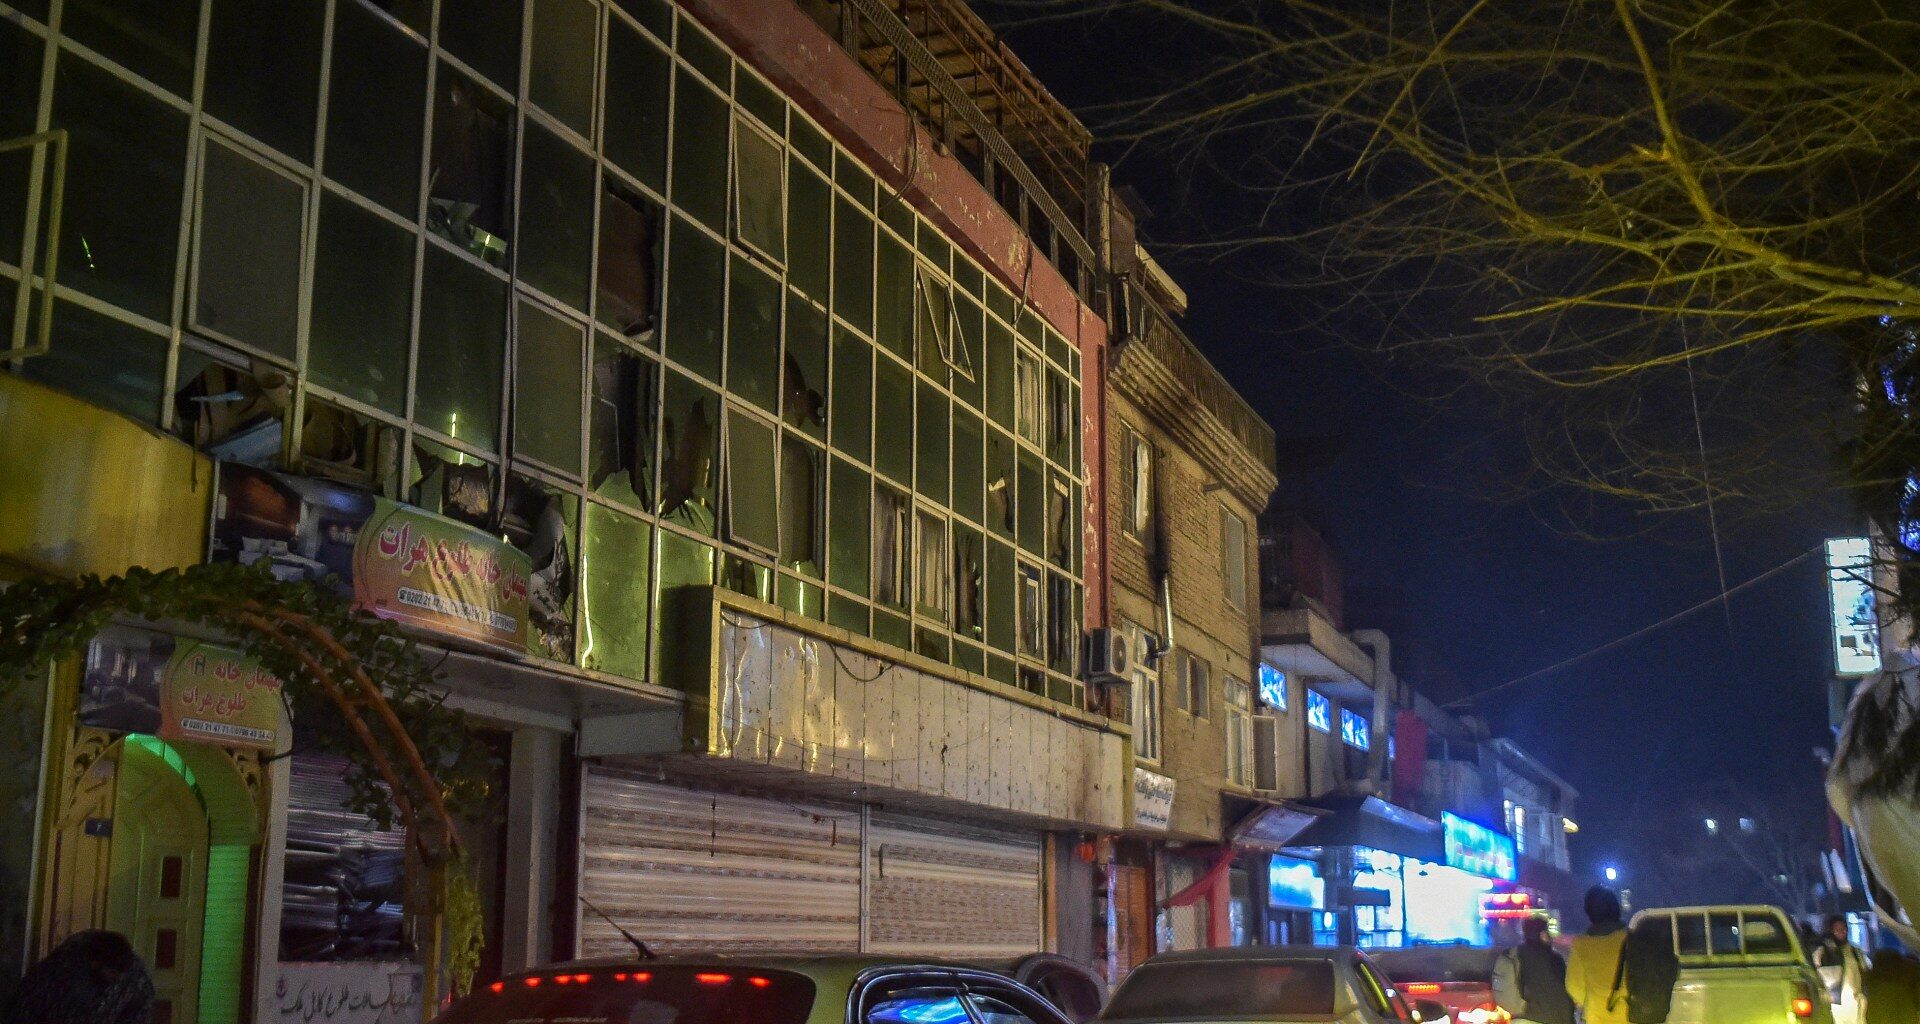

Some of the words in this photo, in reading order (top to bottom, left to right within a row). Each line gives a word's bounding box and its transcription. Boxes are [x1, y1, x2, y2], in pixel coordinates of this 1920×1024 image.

[379, 522, 429, 577] هرات
[214, 660, 241, 681] خانه
[181, 685, 214, 714] هرات
[215, 691, 247, 717] طلوع
